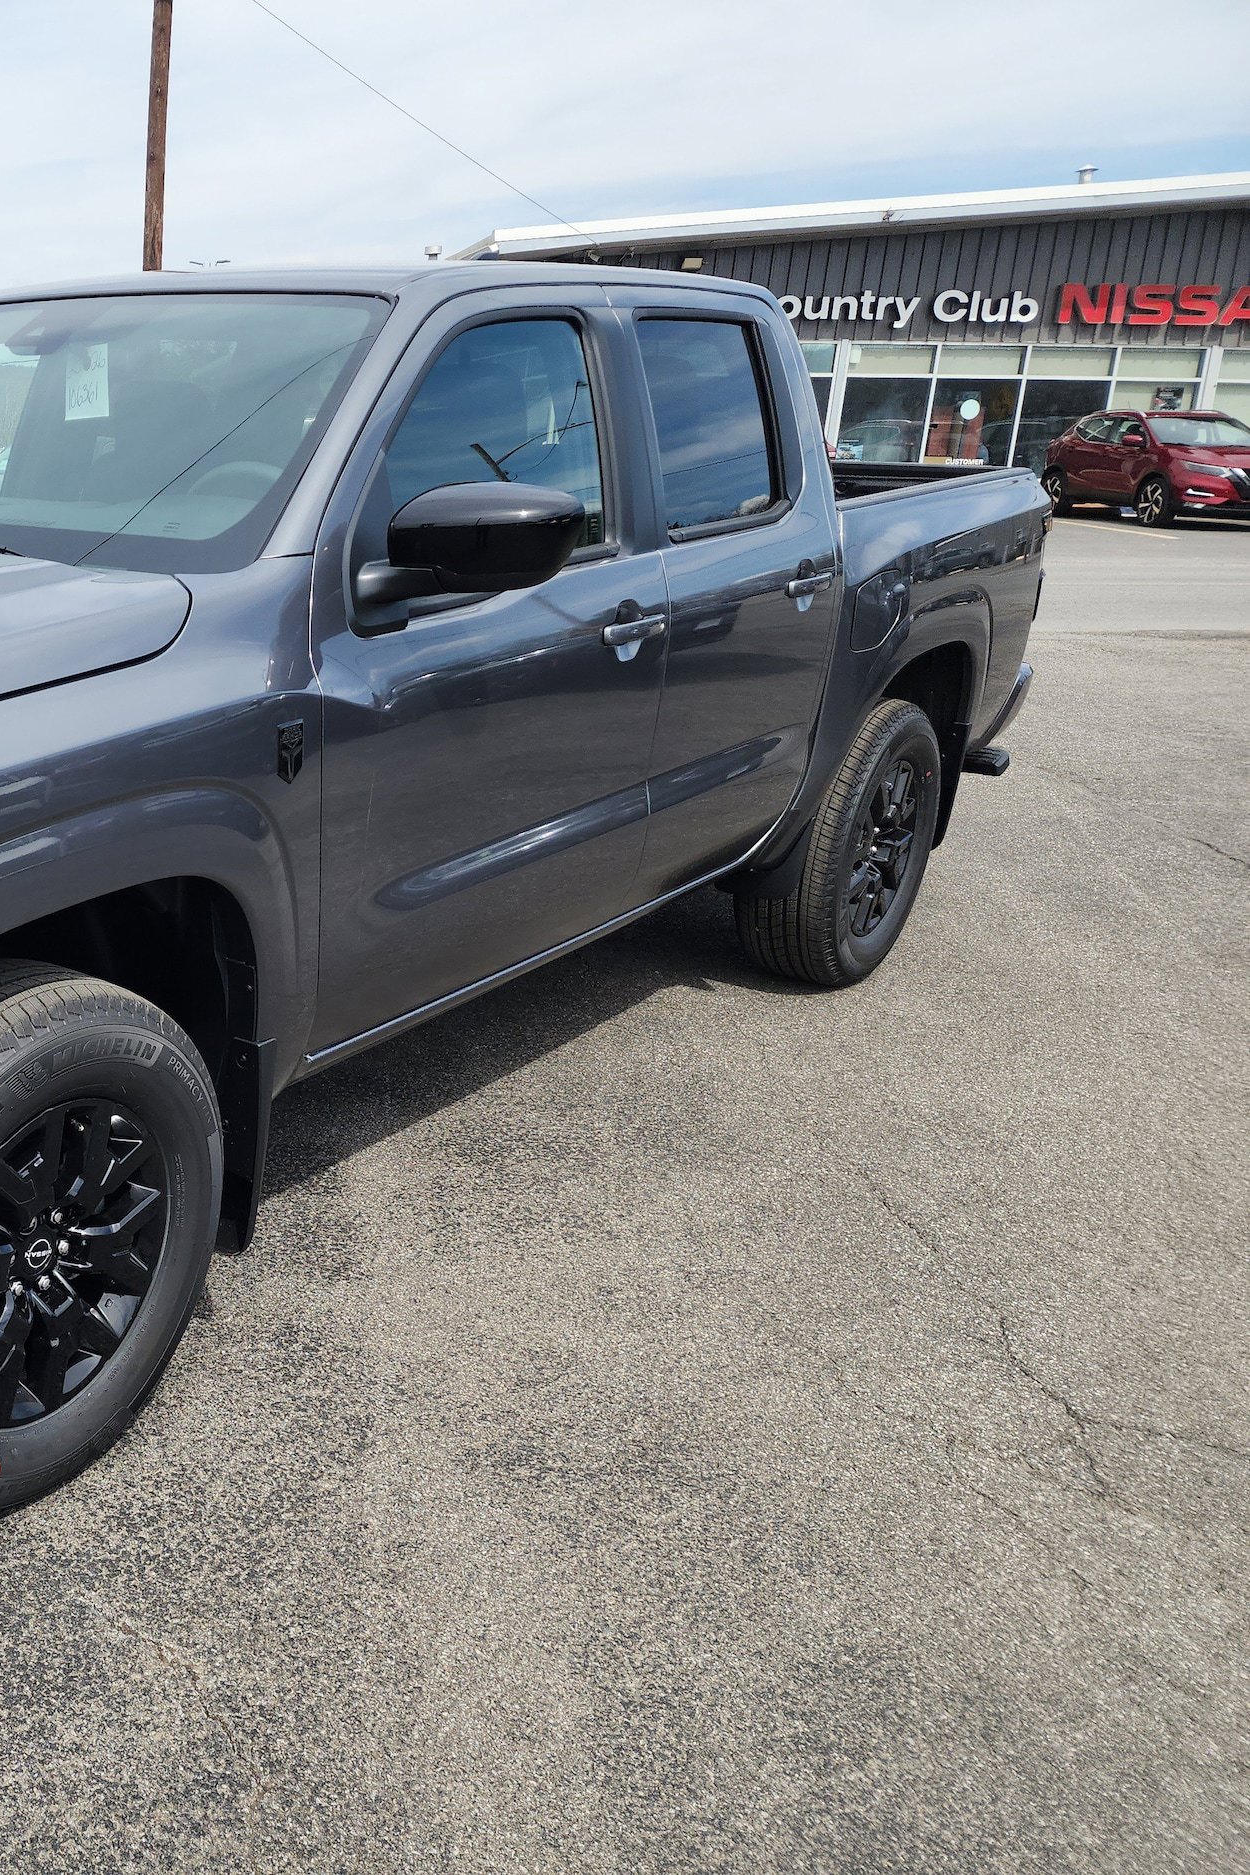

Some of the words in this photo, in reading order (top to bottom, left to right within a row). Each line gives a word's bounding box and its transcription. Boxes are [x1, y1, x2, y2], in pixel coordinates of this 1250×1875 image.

[777, 290, 921, 328] ountry
[933, 289, 1039, 323] Club
[1056, 283, 1250, 326] NISSA
[52, 1037, 158, 1072] MICHELIN
[167, 1055, 204, 1102] PRIMACY
[23, 1249, 52, 1259] NISSAN
